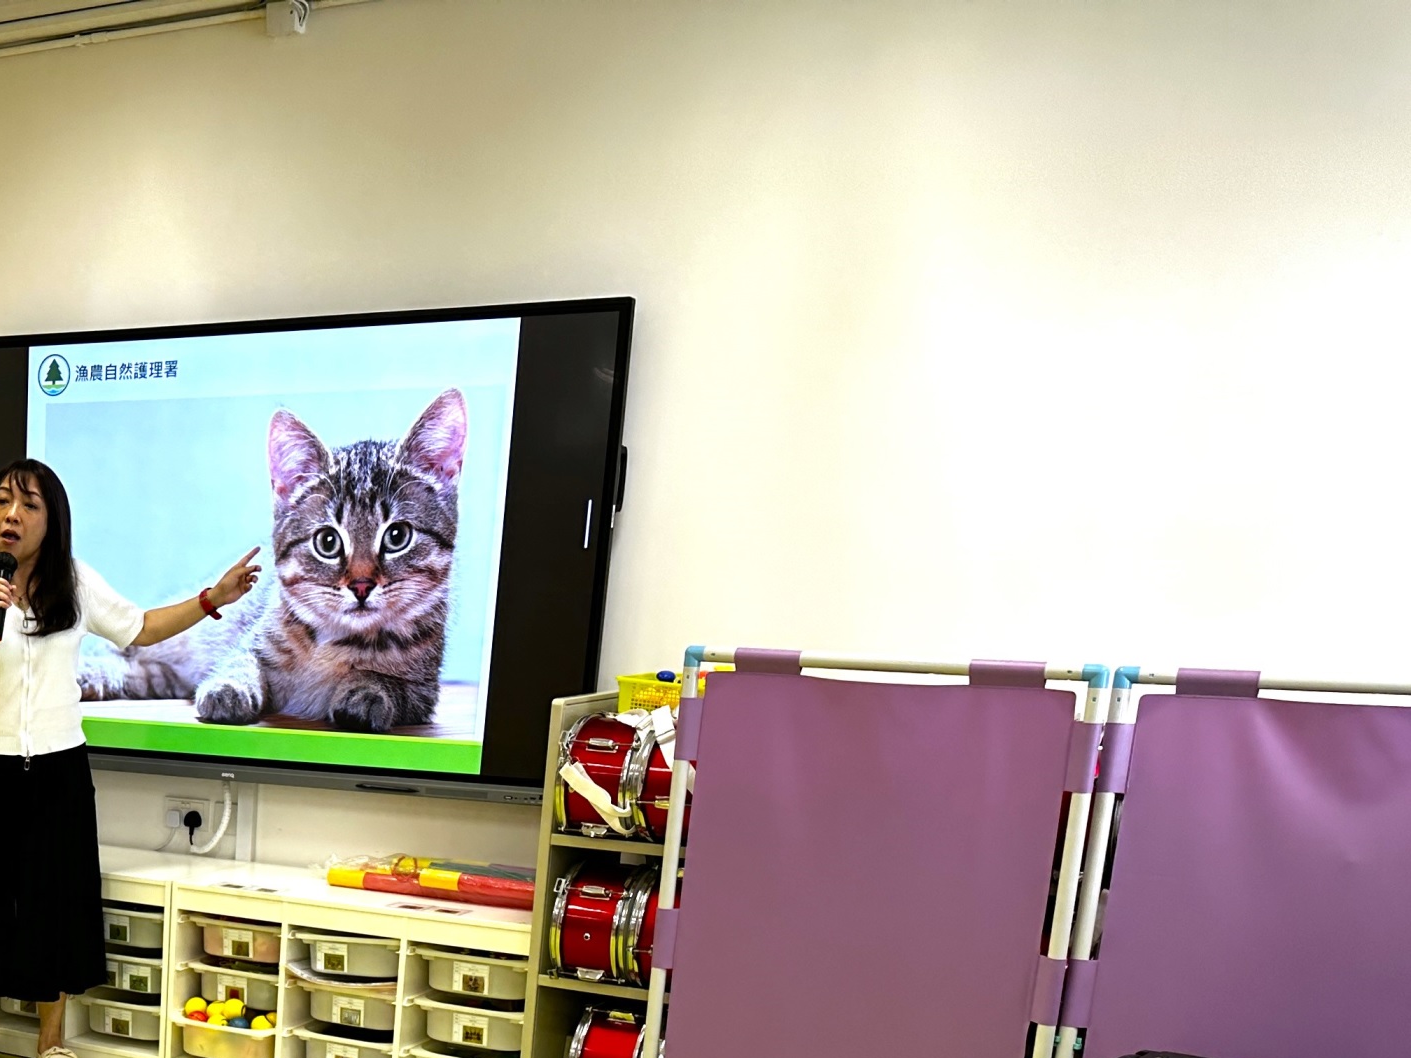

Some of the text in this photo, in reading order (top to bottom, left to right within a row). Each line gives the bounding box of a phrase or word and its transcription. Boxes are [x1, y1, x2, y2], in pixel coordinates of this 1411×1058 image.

[75, 360, 178, 382] 漁農自然護理署
